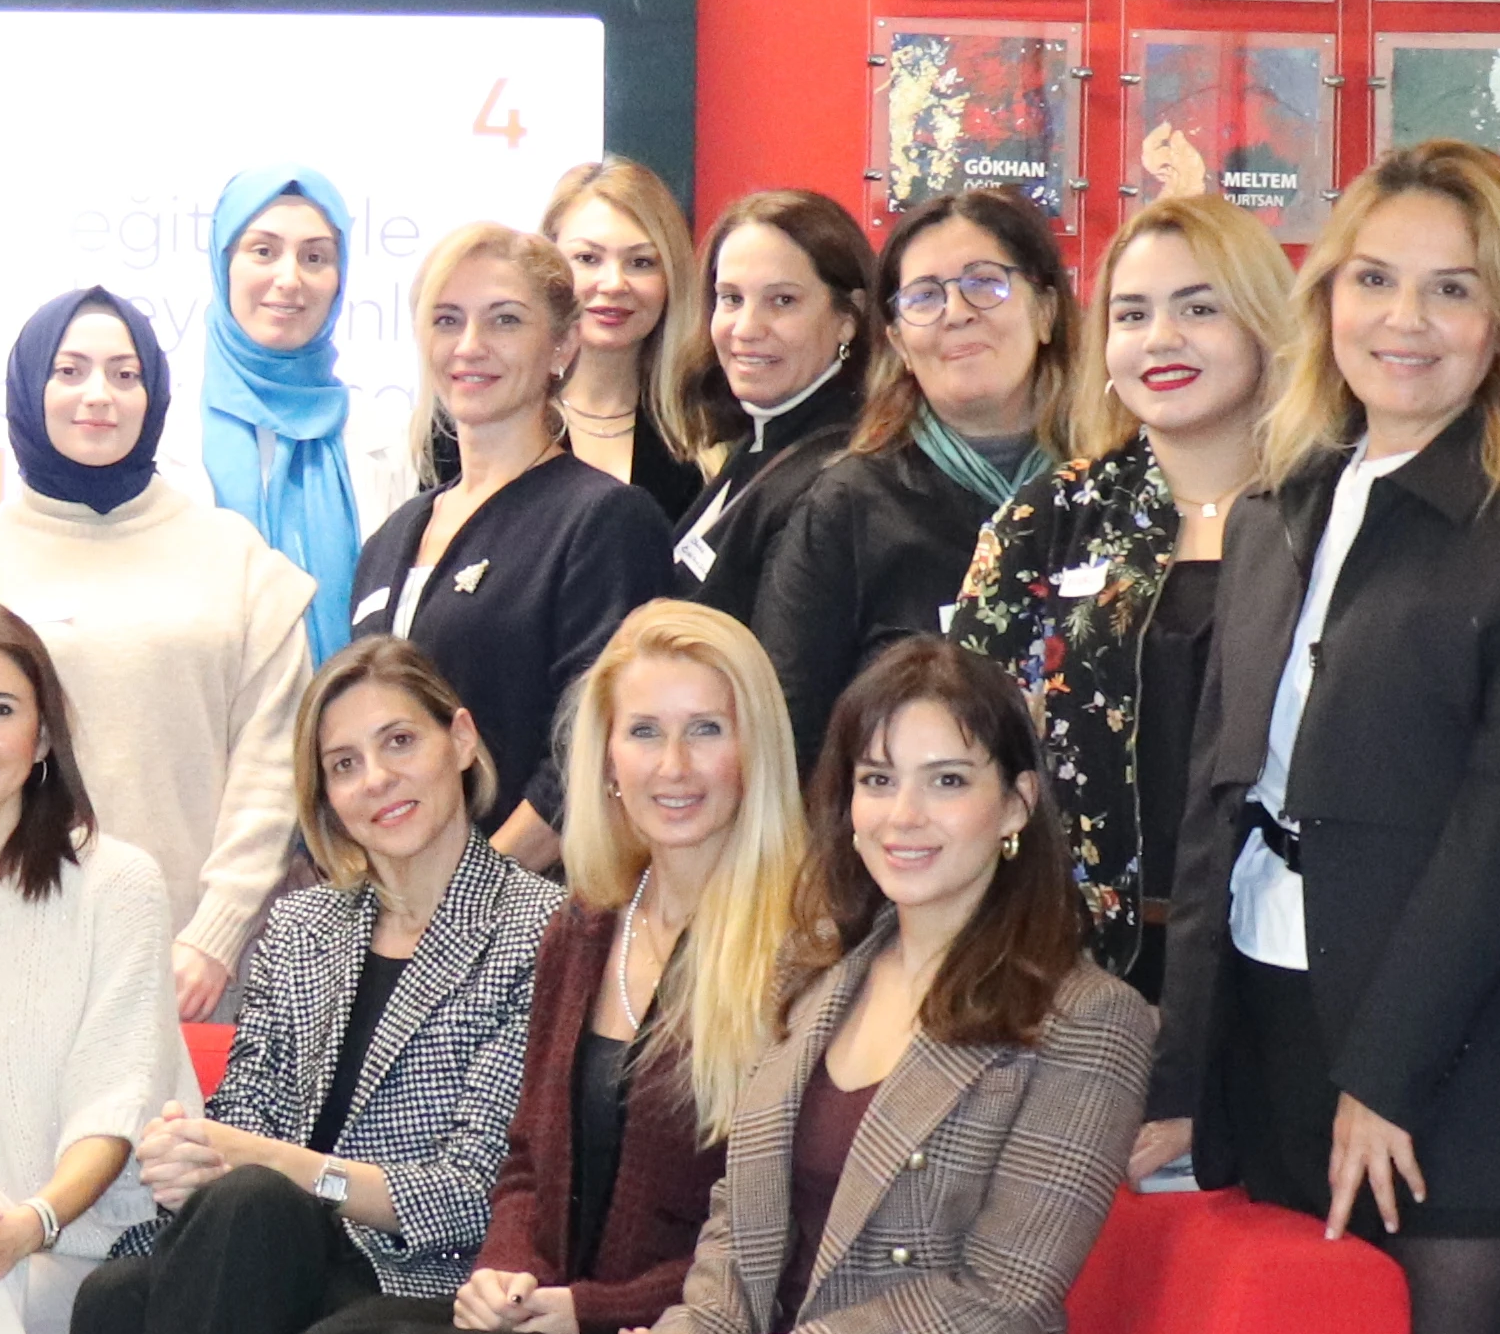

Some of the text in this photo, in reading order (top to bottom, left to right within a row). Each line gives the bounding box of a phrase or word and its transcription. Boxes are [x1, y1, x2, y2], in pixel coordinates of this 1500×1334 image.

[470, 77, 528, 150] 4
[964, 156, 1046, 178] GÖKHAN
[1223, 171, 1298, 189] MELTEM
